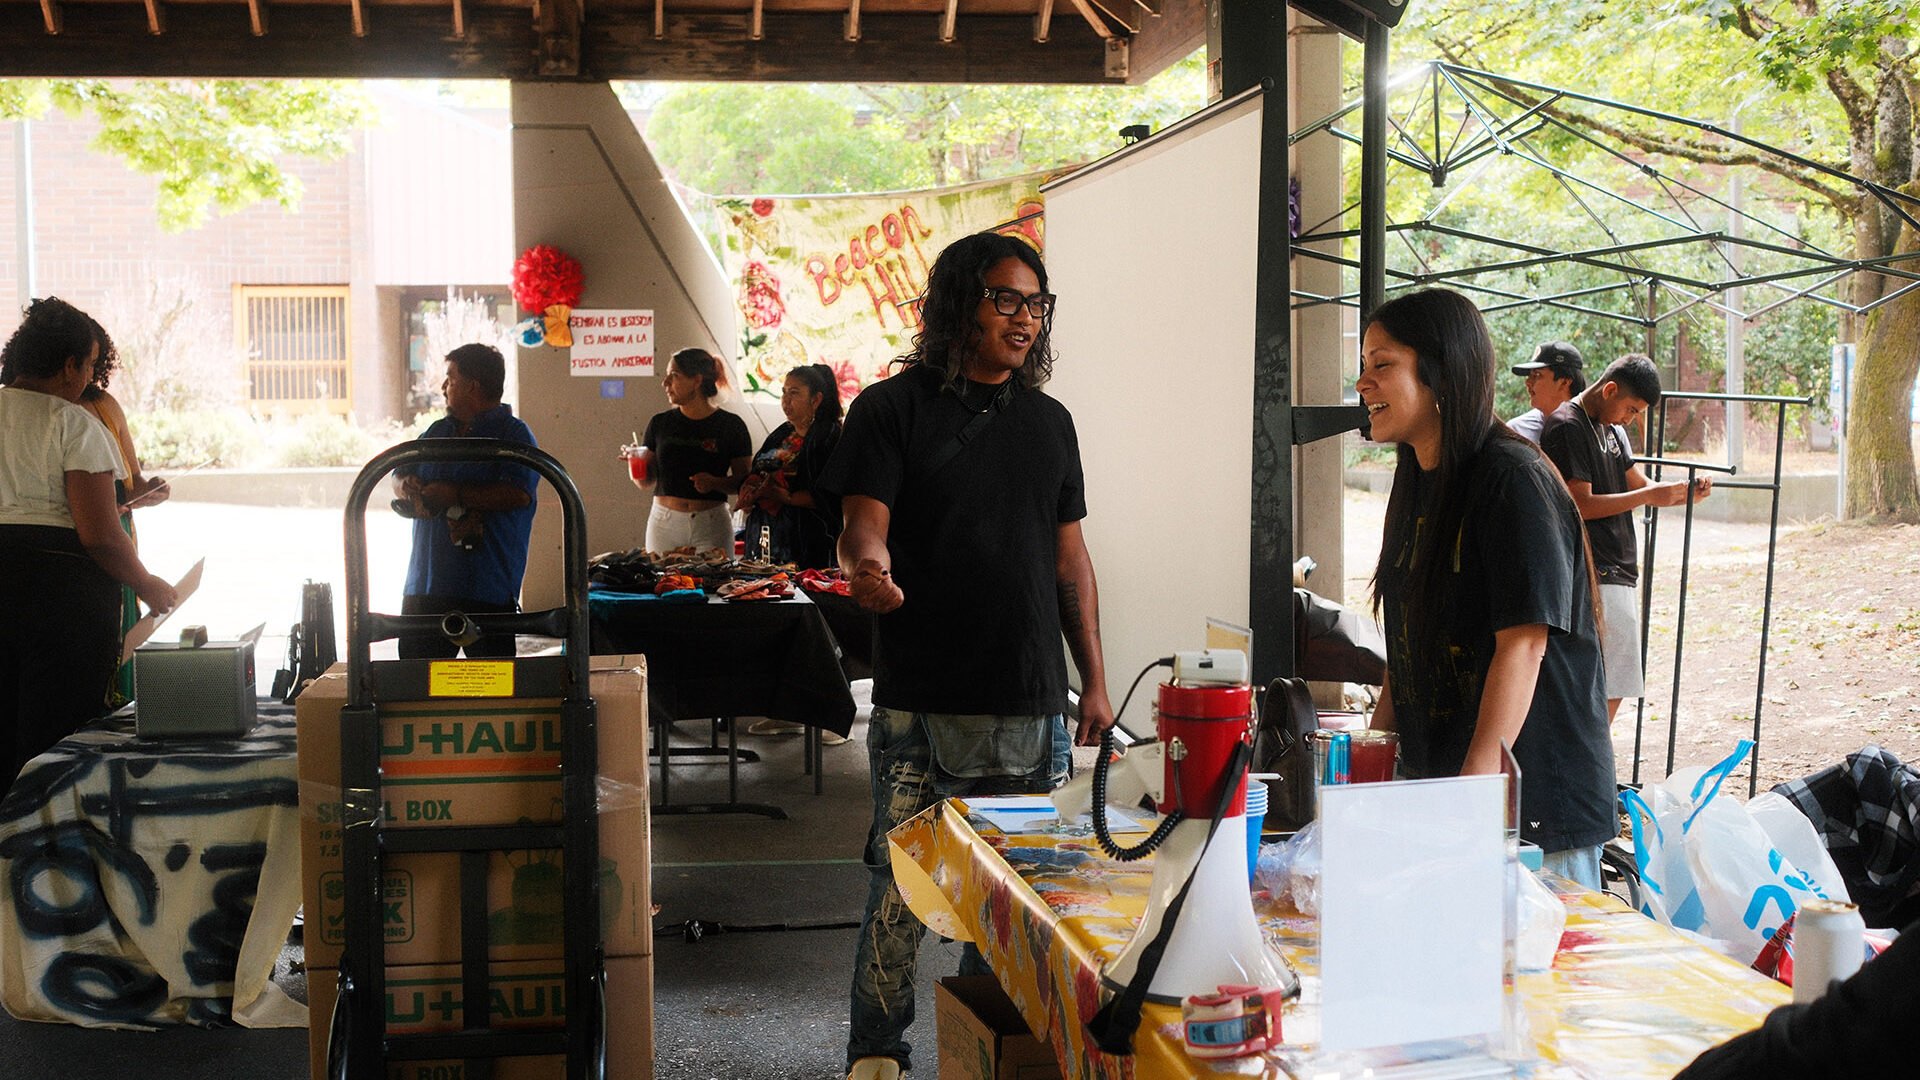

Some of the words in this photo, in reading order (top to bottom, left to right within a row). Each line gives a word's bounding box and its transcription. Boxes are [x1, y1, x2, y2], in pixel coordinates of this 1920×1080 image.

[805, 204, 932, 307] Beacon
[607, 316, 618, 328] ES
[627, 333, 634, 344] A
[636, 332, 647, 344] LA
[379, 720, 562, 756] U-HAUL
[406, 800, 453, 822] BOX
